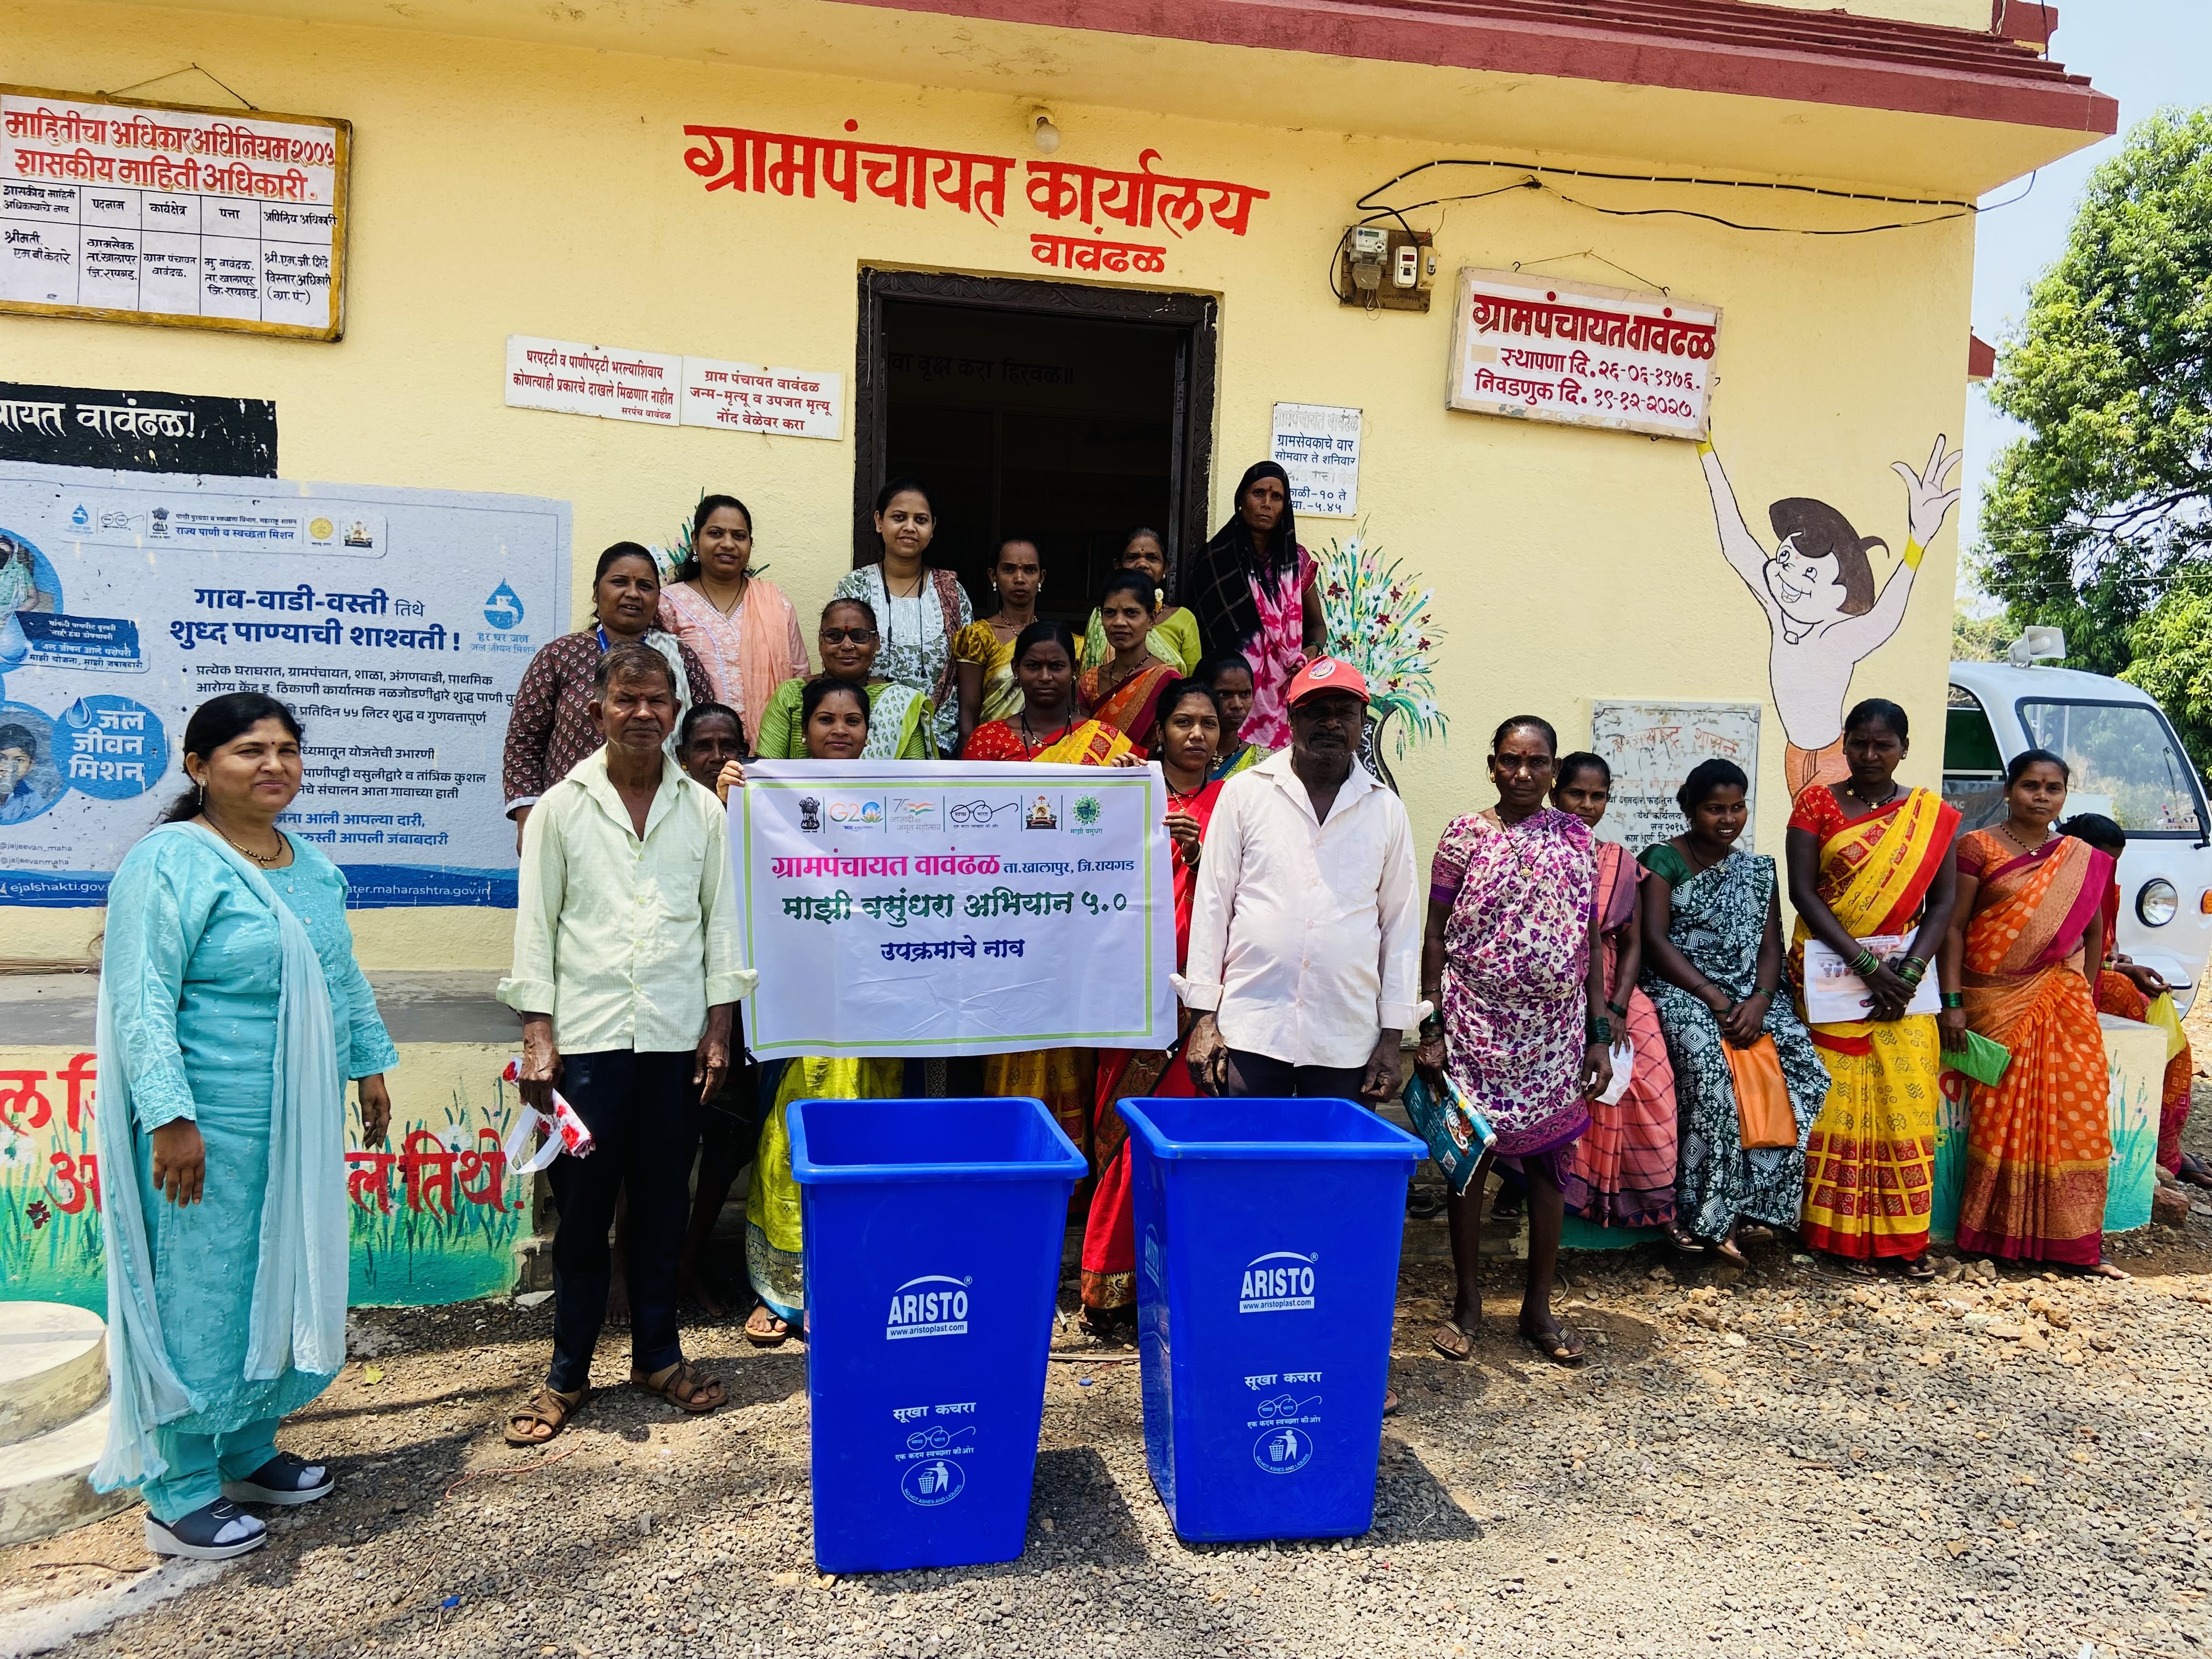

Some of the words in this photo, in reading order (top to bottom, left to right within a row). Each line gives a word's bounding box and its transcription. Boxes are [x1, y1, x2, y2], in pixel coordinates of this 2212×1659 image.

[15, 149, 116, 180] शासकीय
[120, 156, 201, 188] माहिती
[683, 119, 1015, 227] ग्रामपंचायत
[1026, 148, 1270, 239] कार्यालय
[48, 189, 76, 200] माहिती
[92, 199, 125, 212] पदनाम
[149, 201, 188, 216] कार्यक्षेत्र
[87, 237, 134, 250] ग्रामसेवक
[1030, 225, 1167, 273] वावंढळ
[560, 354, 566, 366] व
[612, 359, 663, 380] भरल्याशिवाय
[1500, 348, 1566, 374] स्थापणा
[513, 369, 554, 391] कोणत्याही
[557, 376, 585, 394] प्रकारचे
[589, 380, 614, 397] दाखले
[617, 382, 648, 402] मिळणार
[651, 387, 674, 405] नाहीत
[706, 370, 727, 382] ग्राम
[731, 370, 772, 388] पंचायत
[777, 376, 820, 392] वावंढळ
[1475, 368, 1554, 405] निवडणुक
[753, 393, 761, 404] व
[766, 394, 803, 409] उपजत
[622, 406, 642, 416] सरपंच
[646, 408, 671, 420] वावंढळ
[742, 413, 778, 430] वेळेवर
[782, 417, 805, 431] करा
[1277, 432, 1333, 449] ग्रामसेवकाचे
[1337, 439, 1353, 452] वार
[1275, 448, 1308, 462] सोमवार
[1312, 451, 1319, 463] ते
[1323, 453, 1356, 466] शनिवार
[176, 527, 196, 535] राज्य
[199, 527, 219, 537] पाणी
[233, 529, 266, 539] स्वच्छता
[269, 529, 294, 539] मिशन
[394, 600, 425, 617] तिथे
[233, 618, 343, 645] पाण्याची
[350, 624, 446, 650] शाश्वती
[196, 663, 231, 675] प्रत्येक
[234, 666, 285, 678] घराघरात,
[288, 665, 351, 680] ग्रामपंचायत,
[354, 669, 386, 681] शाळा,
[448, 673, 493, 686] प्राथमिक
[196, 681, 235, 693] आरोग्य
[276, 681, 320, 696] ठिकाणी
[323, 683, 376, 697] कार्यात्मक
[477, 690, 503, 703] पाणी
[97, 709, 146, 730] जल
[299, 705, 340, 718] प्रतिदिन
[362, 707, 390, 719] लिटर
[416, 711, 425, 720] व
[72, 727, 145, 755] जीवन
[349, 744, 392, 759] योजनेची
[395, 746, 435, 760] उभारणी
[69, 753, 145, 782] मिशन
[405, 771, 414, 781] व
[454, 772, 486, 785] कुशल
[317, 783, 359, 796] संचालन
[362, 787, 388, 797] आता
[391, 787, 432, 799] गावाच्या
[435, 787, 459, 799] हाती
[306, 810, 340, 824] आली
[343, 814, 393, 826] आपल्या
[397, 812, 425, 828] दारी,
[340, 830, 383, 844] आपली
[387, 832, 449, 847] जबाबदारी
[897, 825, 913, 833] अमृत
[772, 848, 908, 879] ग्रामपंचायत
[915, 846, 1001, 876] वावंढळ
[783, 889, 853, 925] माझी
[861, 888, 954, 928] वसुंधरा
[964, 887, 1074, 918] अभियान
[881, 935, 977, 963] उपक्रमाचे
[983, 939, 1024, 960] नाव
[1240, 1267, 1315, 1299] ARISTO
[888, 1291, 968, 1324] ARISTO
[1243, 1298, 1311, 1311] www.aristoplast.com
[890, 1324, 964, 1336] www.aristoplast.com
[1245, 1374, 1278, 1391] सूखा
[1283, 1372, 1322, 1384] कचरा
[893, 1406, 929, 1423] सूखा
[935, 1402, 977, 1415] कचरा
[1247, 1420, 1257, 1429] एक
[895, 1453, 906, 1462] एक
